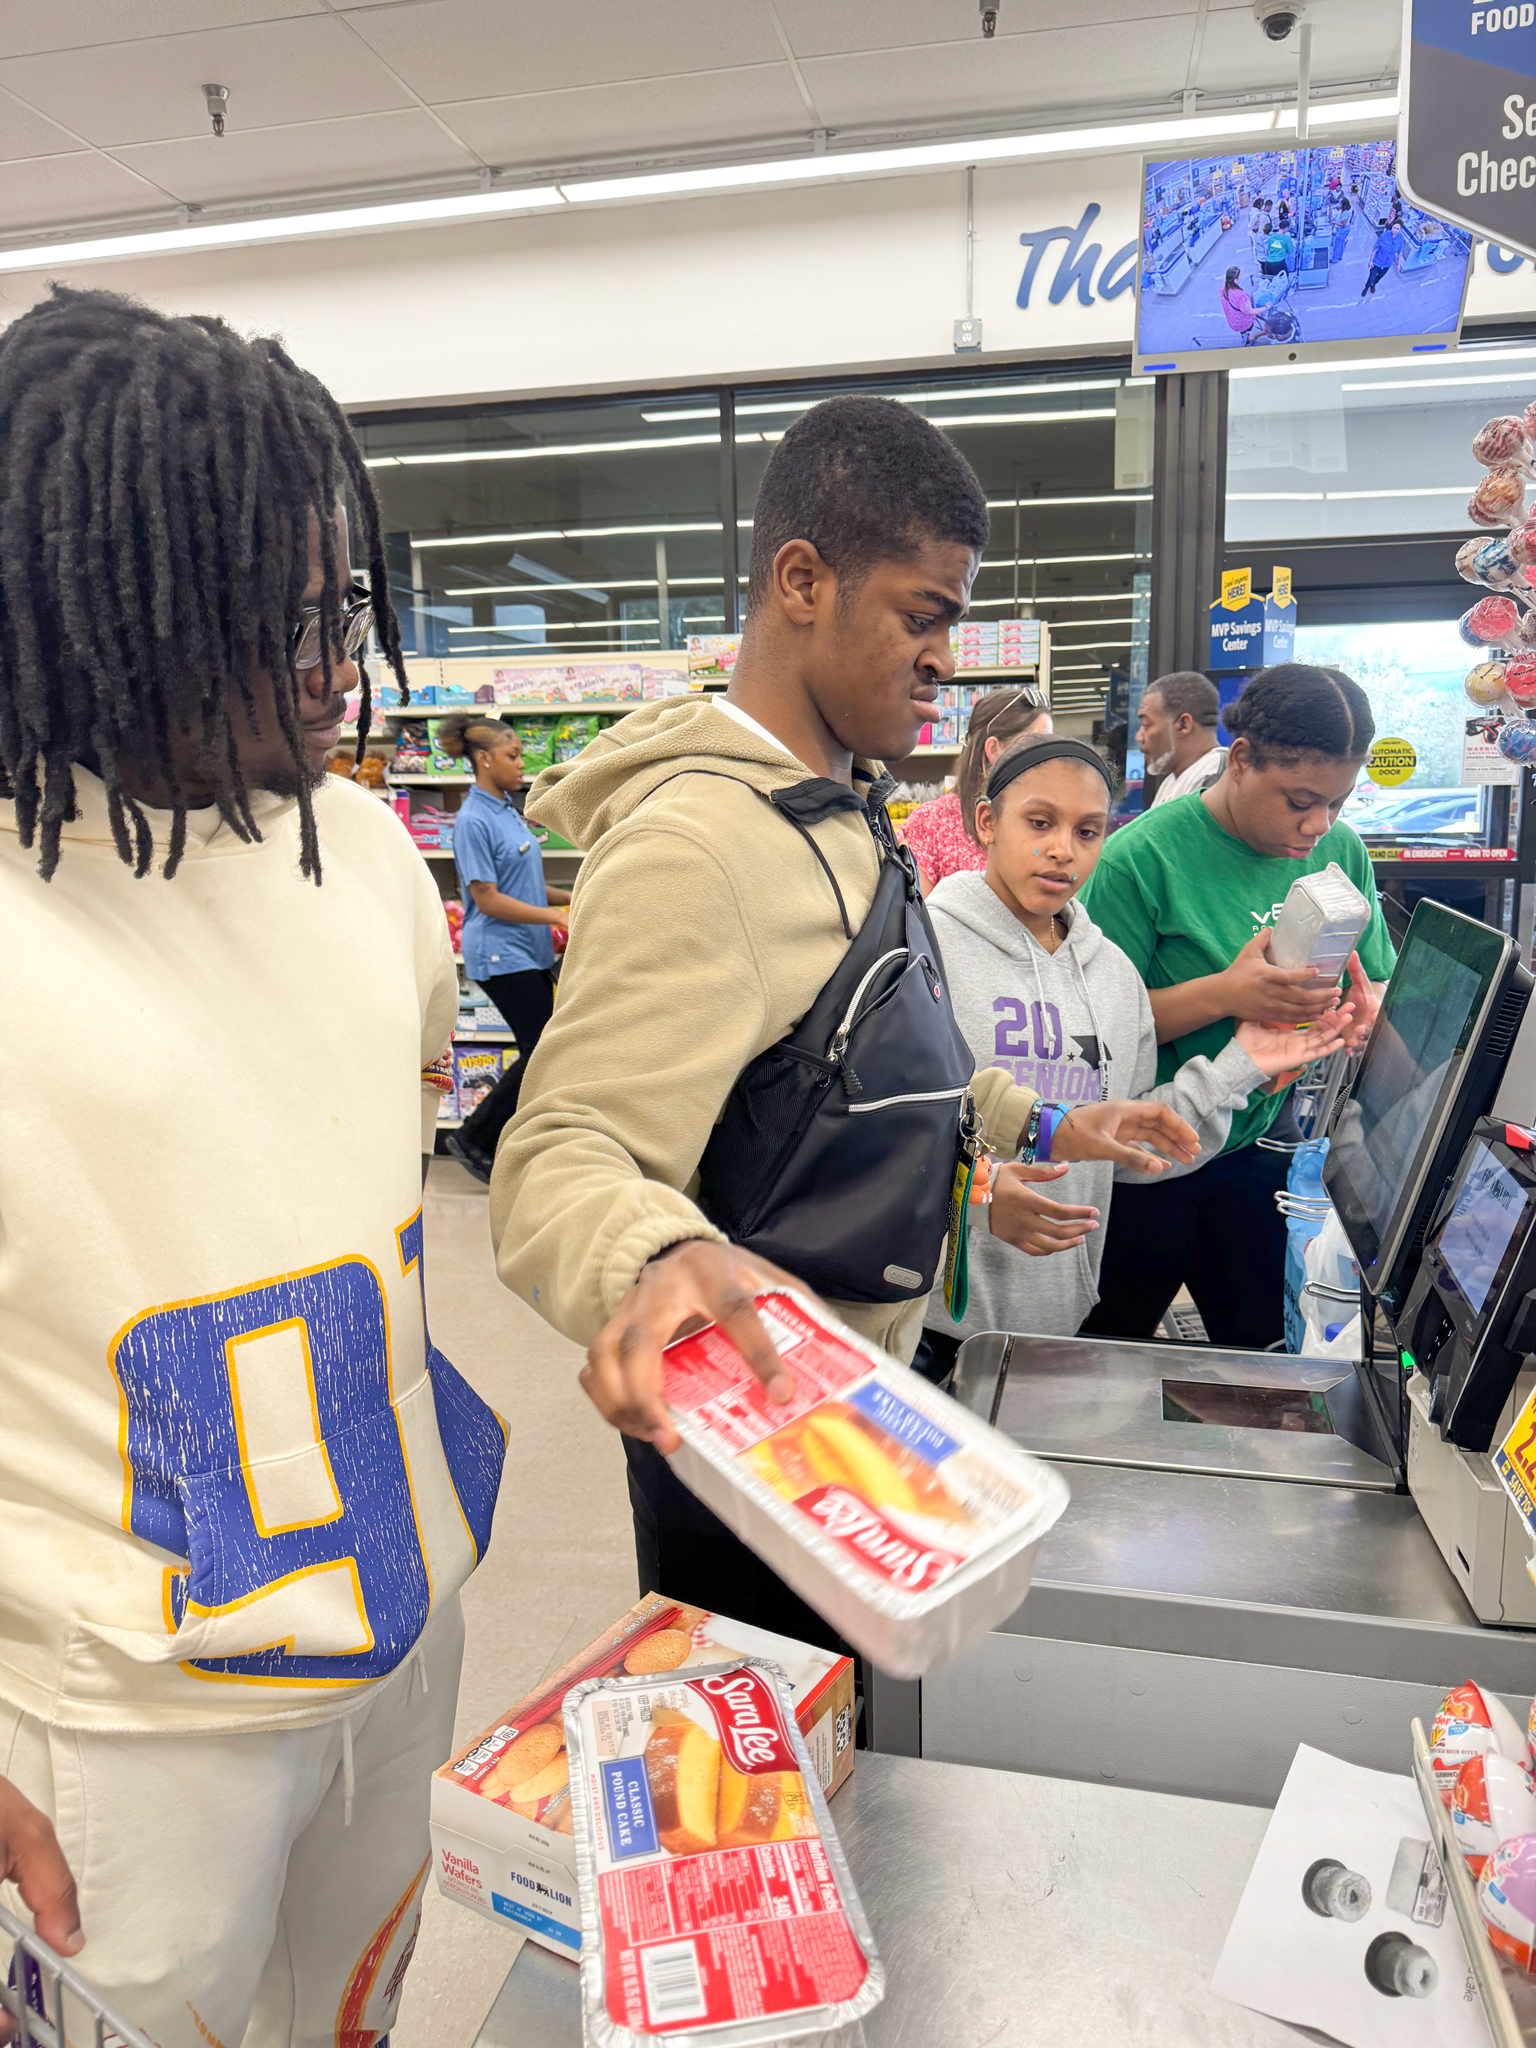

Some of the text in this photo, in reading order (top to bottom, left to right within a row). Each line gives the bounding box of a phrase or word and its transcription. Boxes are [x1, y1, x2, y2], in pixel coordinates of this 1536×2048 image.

[1471, 3, 1535, 35] FOOD
[1456, 151, 1536, 197] Chec
[1227, 584, 1246, 600] HERE!
[1211, 620, 1262, 637] MVP Savings
[1222, 638, 1248, 652] Center
[1403, 849, 1508, 858] IN EMERGENCY PUSH TO OPEN
[992, 996, 1062, 1060] 20
[1508, 1475, 1534, 1517] SAVE 70¢
[502, 1727, 516, 1741] 150
[702, 1676, 779, 1767] Sara Lee
[589, 1773, 605, 1851] MOIST AND DELICIOUS
[609, 1771, 632, 1846] POUND CAKE
[626, 1779, 645, 1828] CLASSIC
[441, 1848, 480, 1876] Vanilla
[441, 1860, 483, 1890] Wafers
[760, 1845, 776, 1878] Calories
[772, 1894, 791, 1918] 340
[807, 1840, 838, 1911] Nutrition Facts
[511, 1871, 572, 1908] FOOD LION
